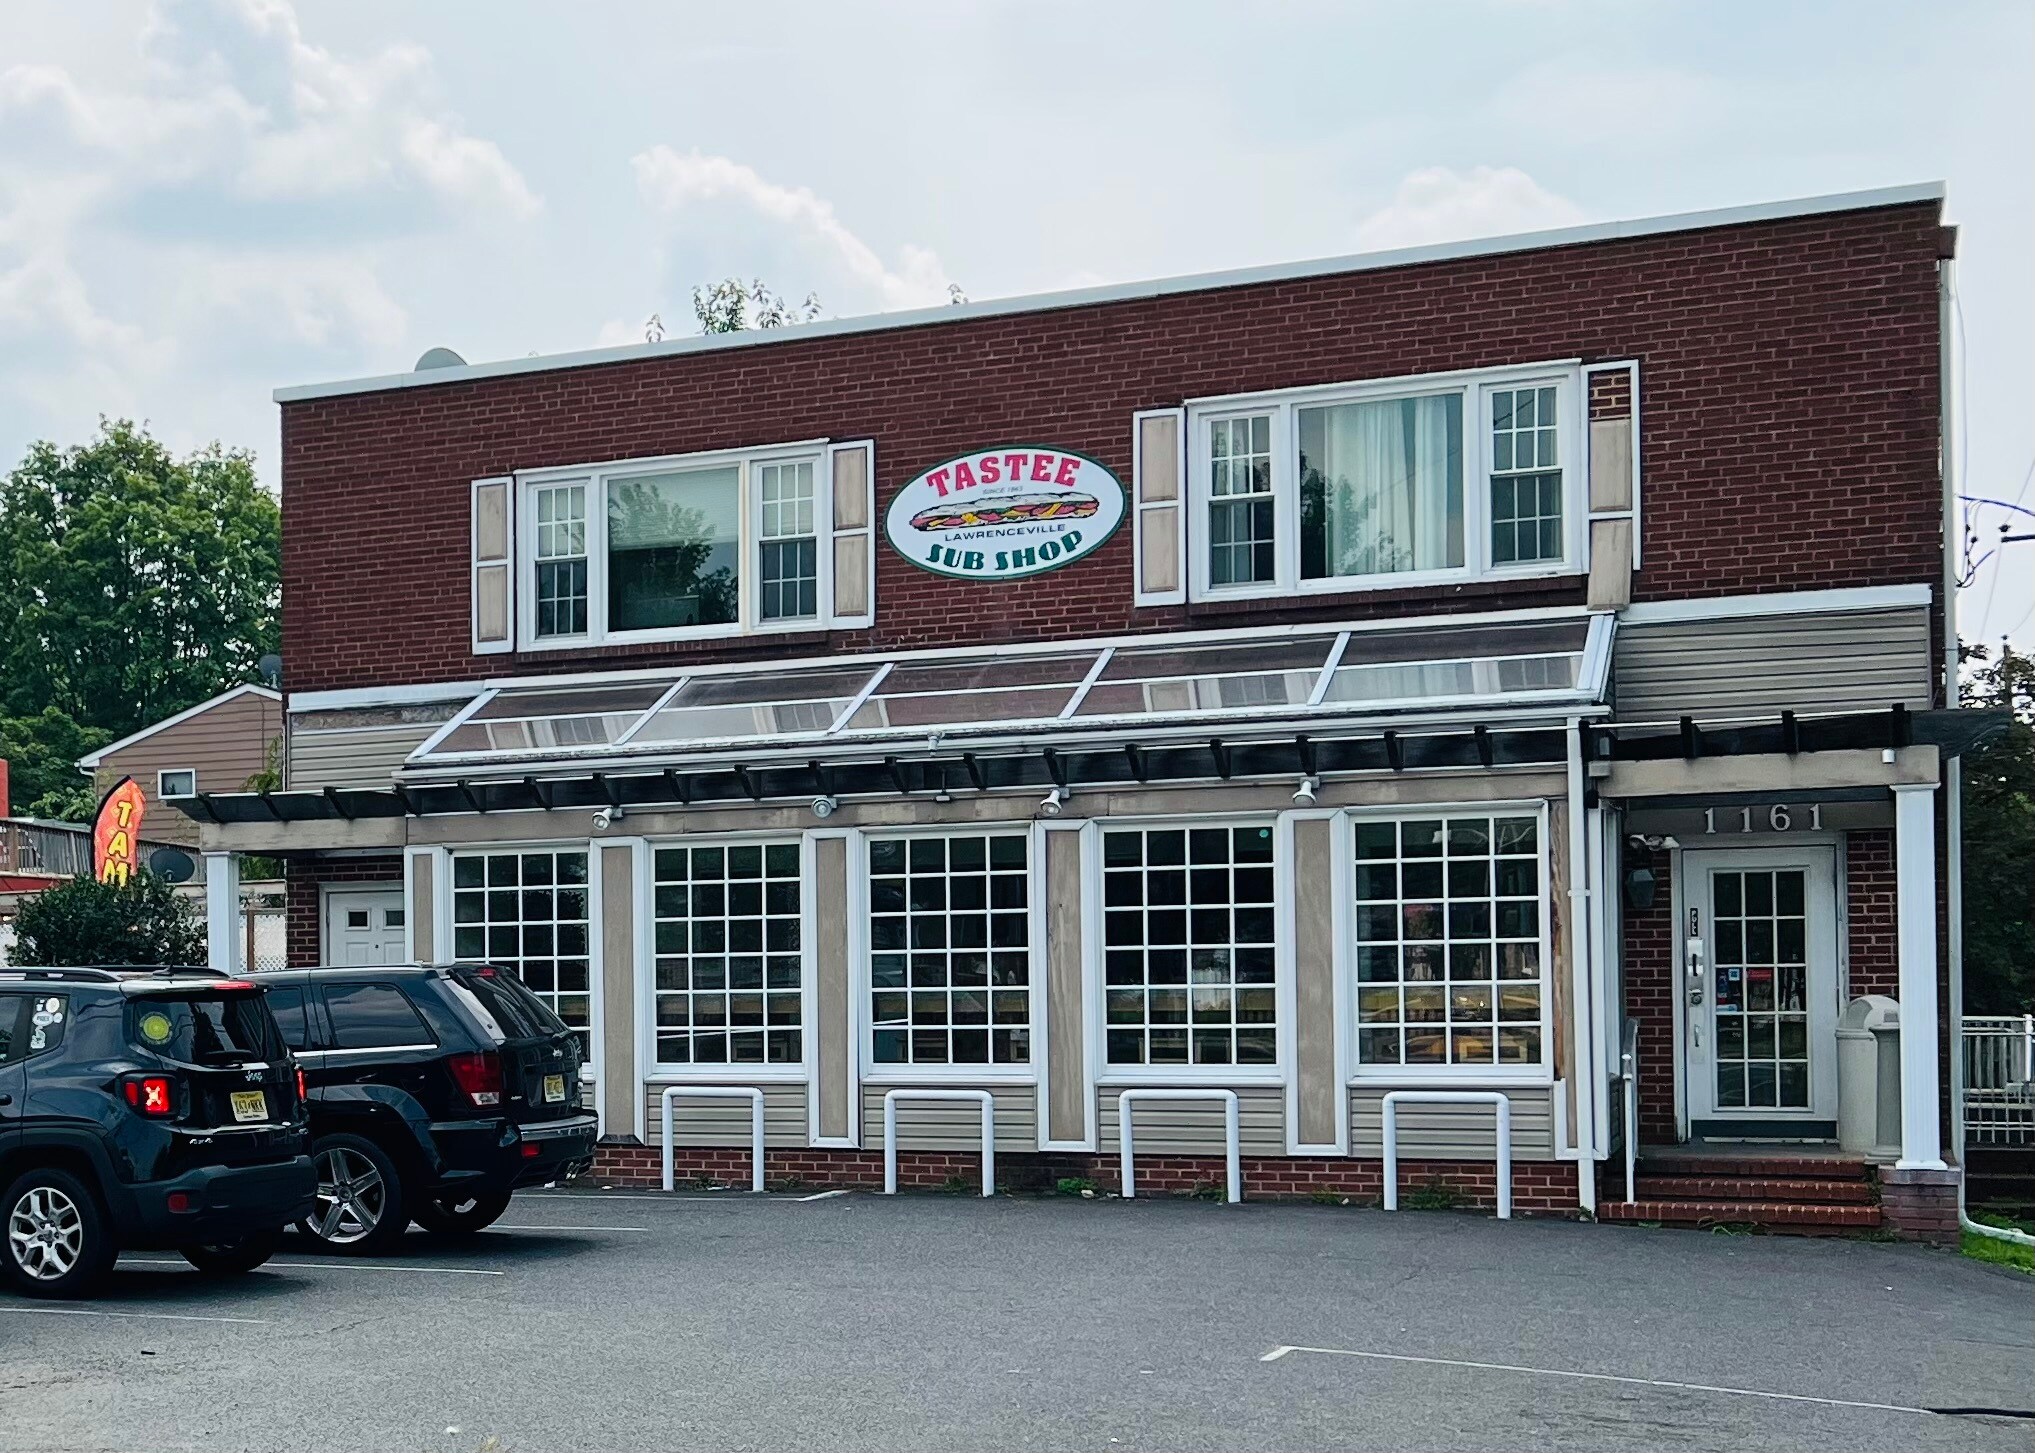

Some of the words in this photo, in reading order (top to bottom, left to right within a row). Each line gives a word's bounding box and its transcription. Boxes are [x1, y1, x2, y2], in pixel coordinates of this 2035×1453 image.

[926, 454, 1081, 497] TASTEE
[925, 543, 985, 570] SUB
[995, 530, 1083, 571] SHOP
[945, 524, 1067, 542] LAWRENCEVILLE
[1704, 804, 1823, 834] 1161
